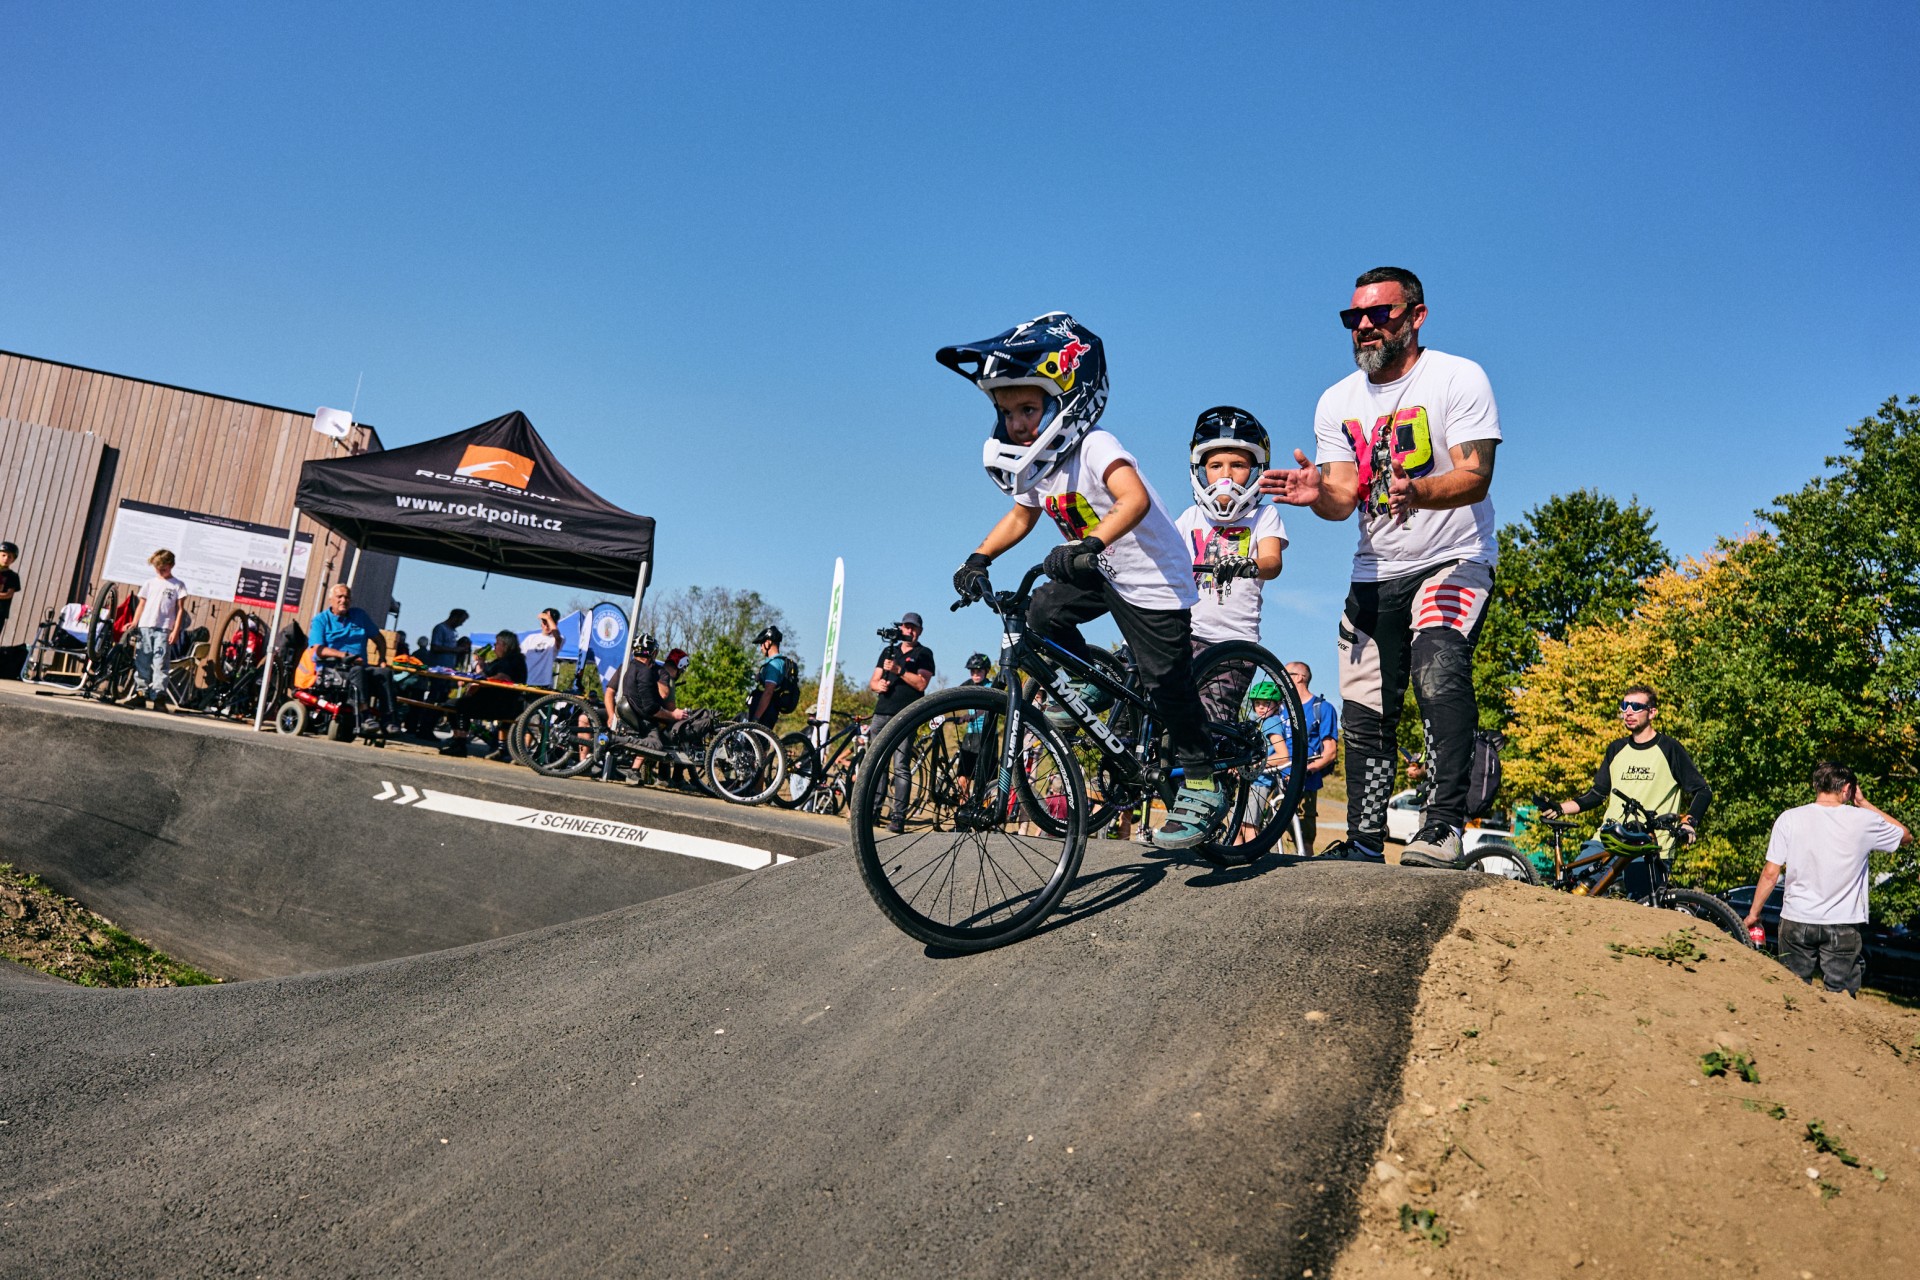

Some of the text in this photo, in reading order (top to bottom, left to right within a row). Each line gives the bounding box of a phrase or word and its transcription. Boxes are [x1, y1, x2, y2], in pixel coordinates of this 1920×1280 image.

[993, 350, 1011, 360] KINI
[415, 469, 561, 502] ROCK POINT
[395, 494, 563, 532] www.rockpoint.cz
[1050, 676, 1125, 754] MEYBO
[1008, 709, 1021, 758] MEYBO
[1627, 765, 1650, 774] Horse
[541, 814, 649, 842] SCHNEESTERN
